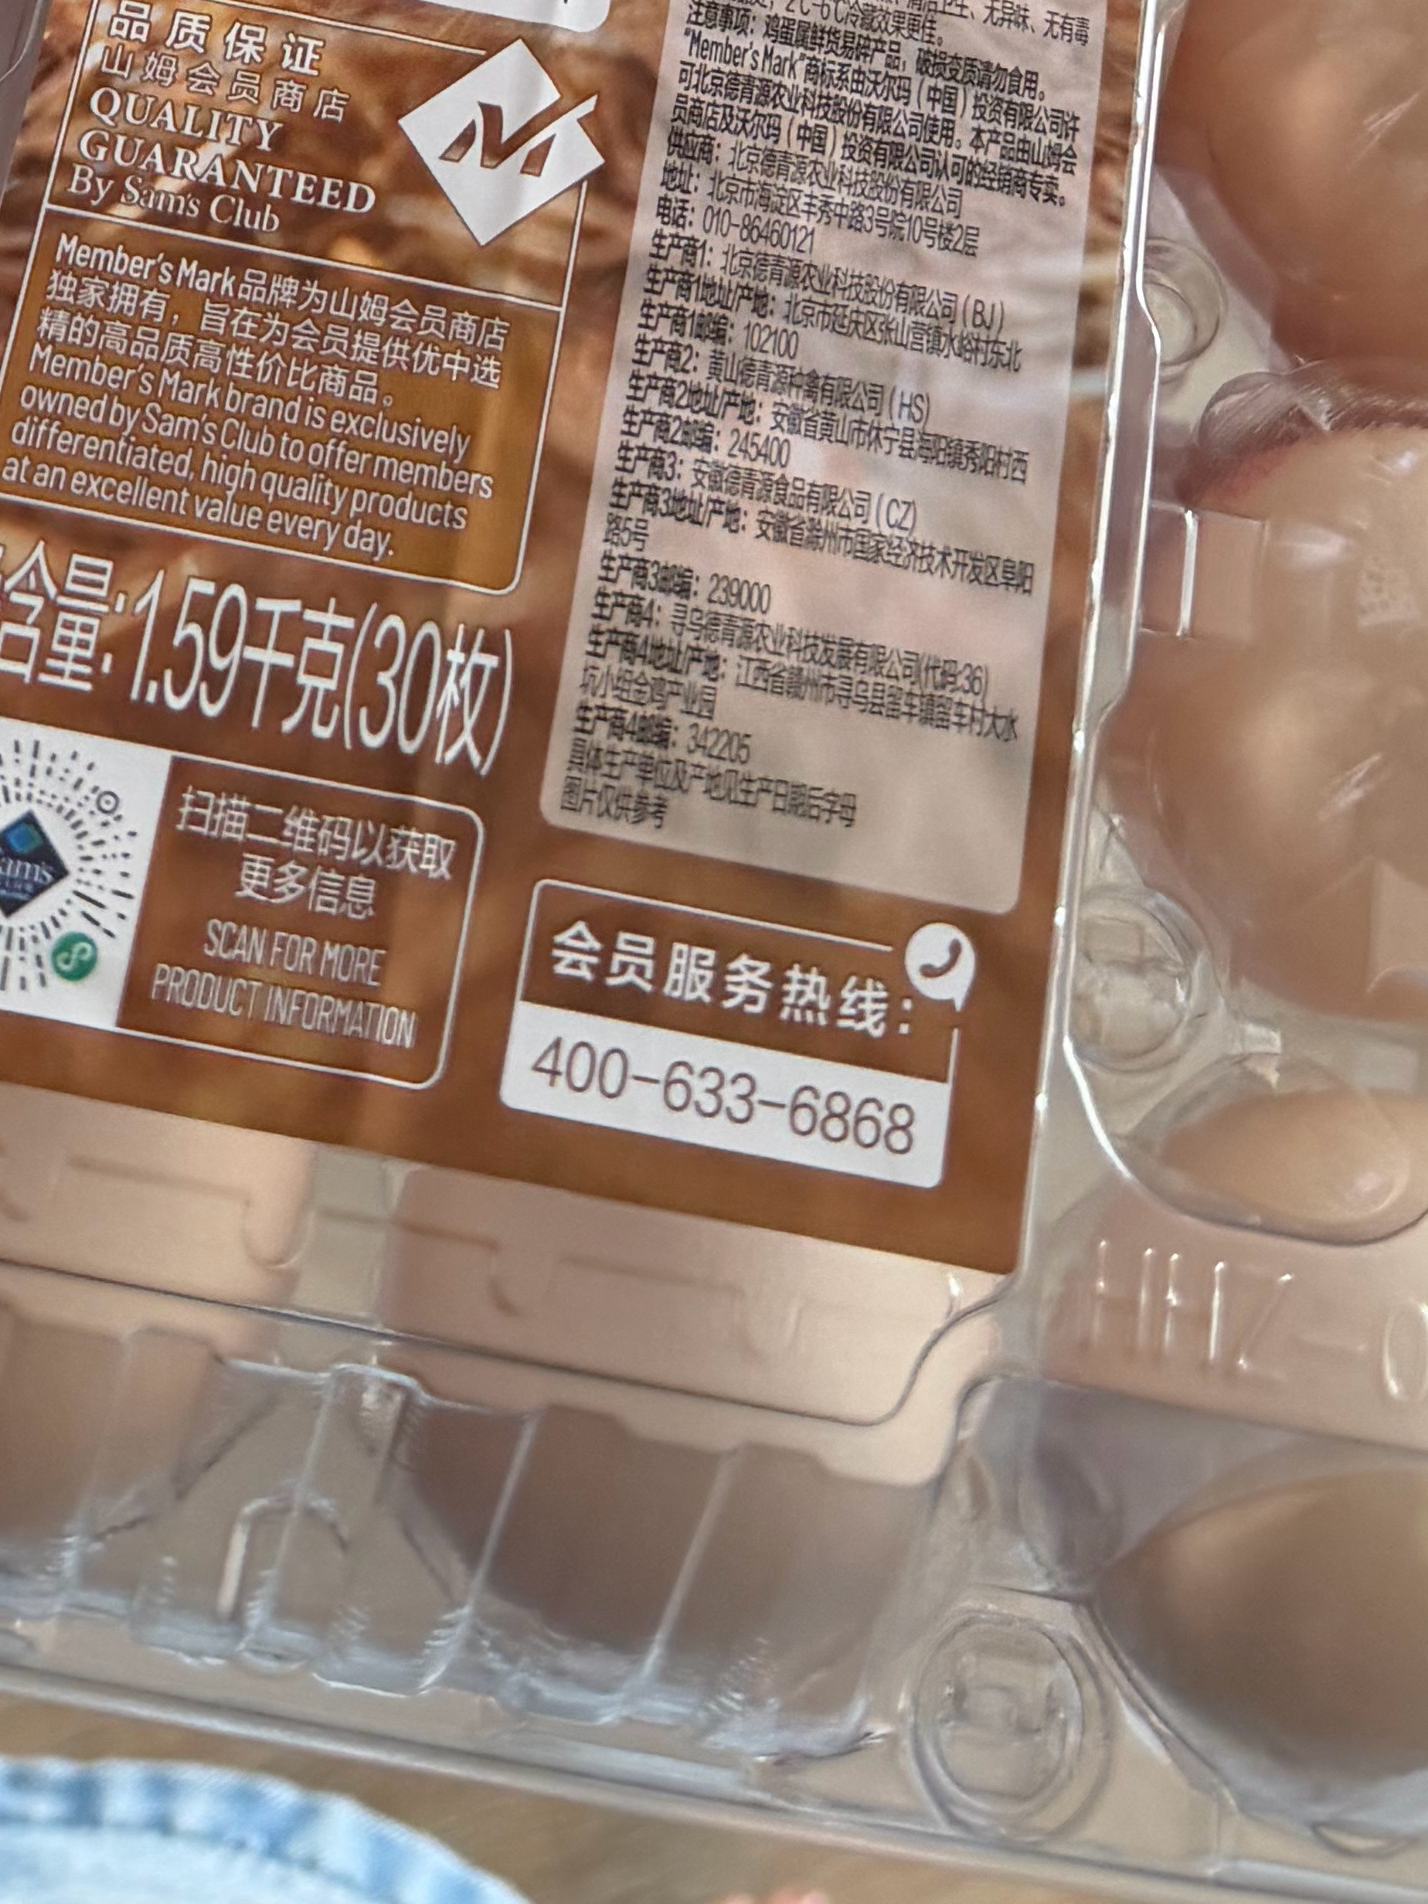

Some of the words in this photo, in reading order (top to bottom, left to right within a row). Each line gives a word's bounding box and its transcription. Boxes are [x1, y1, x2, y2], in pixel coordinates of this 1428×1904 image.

[85, 84, 284, 160] QUALITY
[98, 41, 351, 124] 山姆会员商店
[64, 163, 117, 208] By
[119, 175, 204, 219] Sam's
[206, 193, 283, 235] Club
[75, 126, 378, 218] GUARANTEED
[54, 230, 177, 286] Member's
[18, 375, 109, 425] owned
[105, 395, 142, 438] by
[140, 401, 219, 447] Sam's
[218, 416, 277, 458] Club
[277, 432, 306, 463] to
[306, 435, 371, 477] offer
[371, 447, 495, 501] members
[27, 340, 157, 398] Member's
[156, 366, 223, 410] Mark
[224, 380, 302, 426] brand
[303, 397, 328, 430] is
[327, 400, 472, 467] exclusively
[0, 450, 32, 484] at
[32, 459, 68, 490] an
[68, 461, 192, 518] excellent
[190, 486, 265, 531] value
[263, 504, 342, 555] every
[340, 518, 398, 566] day.
[8, 411, 200, 483] differentiated,
[197, 450, 258, 499] high
[257, 462, 350, 518] quality
[347, 480, 470, 543] products
[173, 782, 458, 887] 扫描二维码以获取
[233, 851, 380, 926] 更多信息
[201, 917, 269, 968] SCAN
[269, 930, 318, 977] FOR
[317, 937, 386, 989] MORE
[148, 960, 265, 1022] PRODUCT
[262, 980, 420, 1052] INFORMATION
[528, 1028, 920, 1160] 400-633-6868
